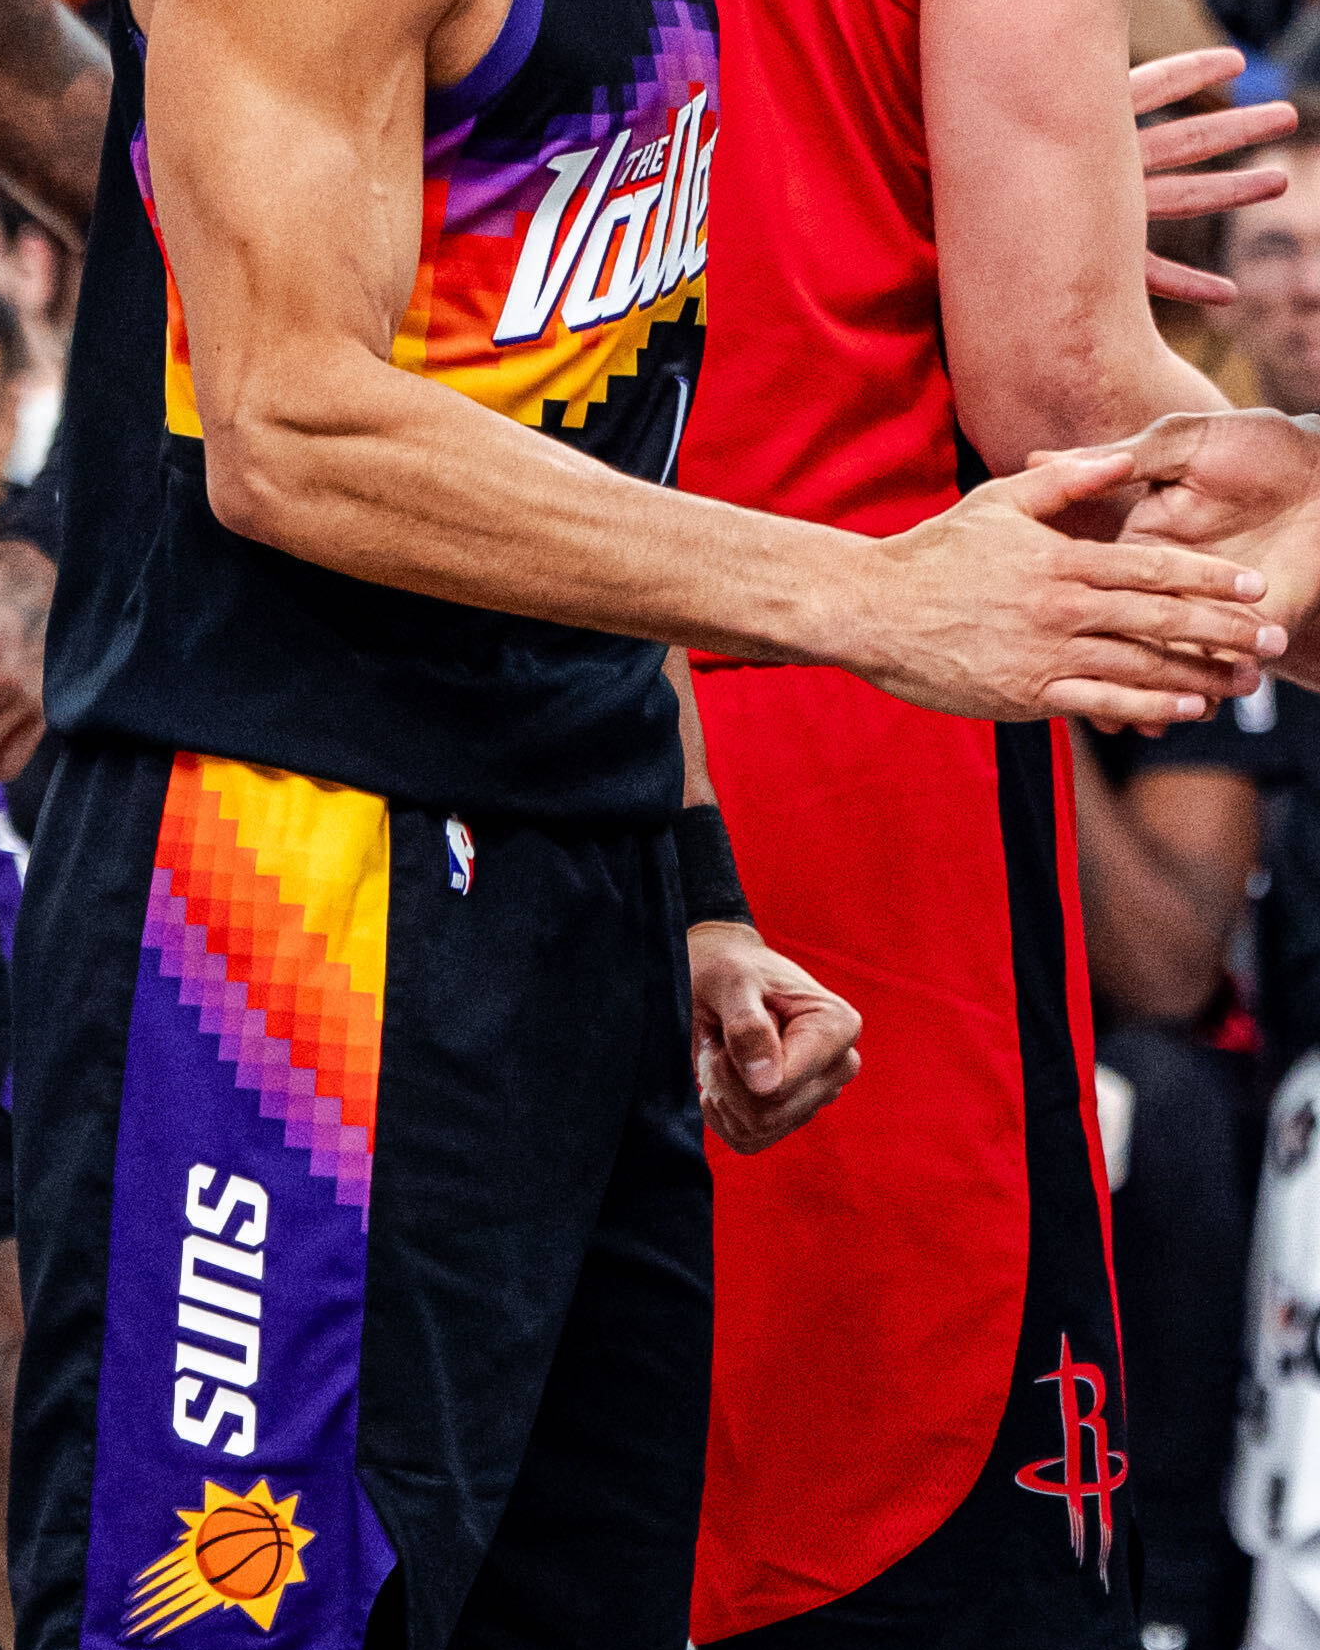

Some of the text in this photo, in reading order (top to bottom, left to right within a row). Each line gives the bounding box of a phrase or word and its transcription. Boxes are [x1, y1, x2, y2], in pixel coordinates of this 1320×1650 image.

[492, 88, 719, 348] Valle
[616, 133, 671, 188] THE
[172, 1162, 269, 1458] SUNS
